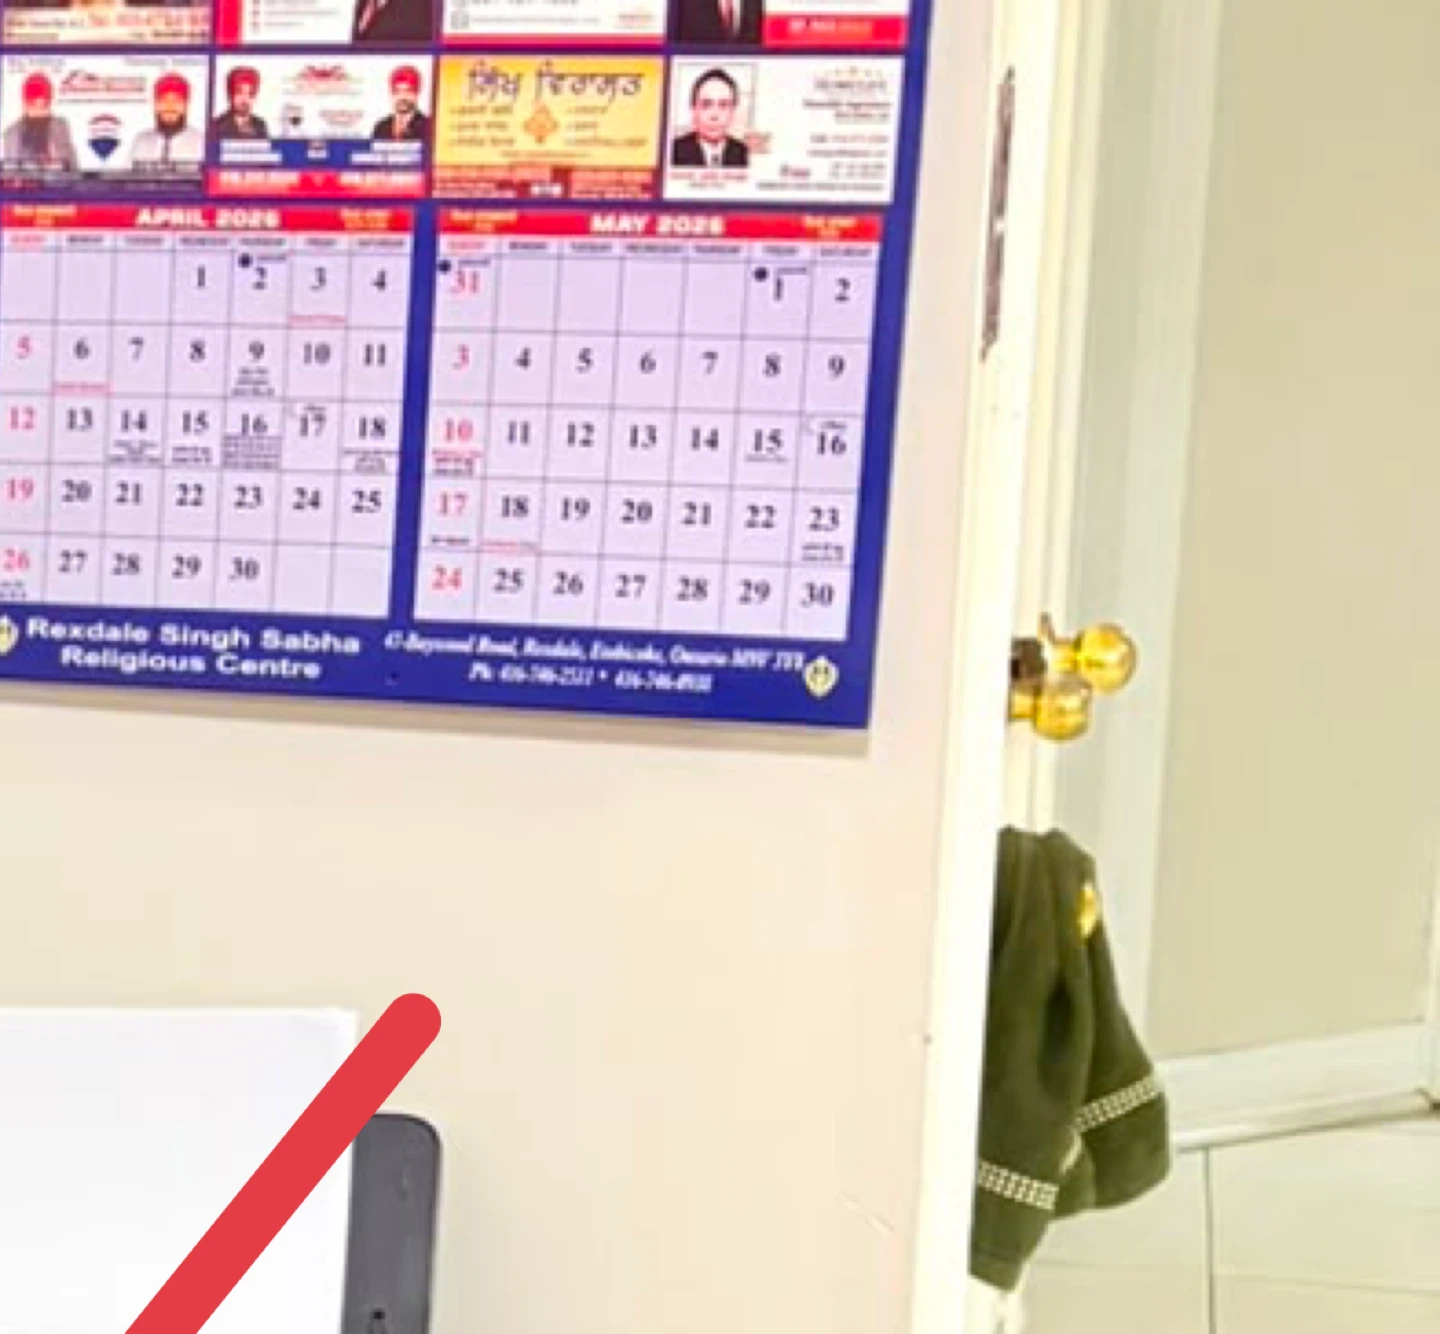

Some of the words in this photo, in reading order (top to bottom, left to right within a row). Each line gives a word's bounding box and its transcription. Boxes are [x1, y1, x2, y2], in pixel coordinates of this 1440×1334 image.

[136, 208, 207, 227] APRIL
[590, 215, 649, 232] MAY
[196, 265, 206, 289] 1
[252, 267, 268, 291] 2
[311, 267, 326, 291] 3
[371, 269, 387, 291] 4
[450, 271, 480, 293] 31
[774, 276, 782, 300] 1
[834, 278, 850, 302] 2
[17, 336, 30, 359] 5
[74, 339, 89, 360] 6
[129, 337, 144, 359] 7
[190, 341, 206, 361] 8
[249, 341, 265, 362] 9
[304, 343, 330, 365] 10
[364, 344, 386, 366] 11
[454, 345, 469, 368] 3
[516, 347, 531, 368] 4
[577, 348, 592, 373] 5
[640, 350, 656, 373] 6
[703, 351, 718, 374] 7
[764, 353, 780, 376] 8
[828, 354, 844, 377] 9
[9, 407, 35, 430] 12
[66, 408, 92, 430] 13
[120, 410, 147, 432] 14
[182, 411, 208, 434] 15
[241, 413, 268, 435] 16
[299, 414, 326, 436] 17
[358, 417, 386, 439] 18
[444, 419, 473, 441] 10
[507, 421, 530, 444] 11
[567, 424, 594, 447] 12
[629, 425, 657, 448] 13
[691, 426, 719, 450] 14
[754, 429, 782, 453] 15
[818, 431, 847, 454] 16
[8, 478, 34, 499] 19
[62, 480, 90, 501] 20
[115, 482, 142, 504] 21
[177, 484, 203, 506] 22
[235, 487, 262, 508] 23
[293, 488, 322, 510] 24
[352, 490, 380, 513] 25
[439, 493, 466, 515] 17
[501, 496, 529, 517] 18
[560, 498, 589, 520] 19
[622, 500, 651, 523] 20
[682, 503, 711, 525] 21
[745, 505, 775, 528] 22
[809, 508, 839, 531] 23
[3, 549, 30, 571] 26
[59, 551, 87, 573] 27
[113, 554, 140, 575] 28
[173, 556, 200, 578] 29
[230, 558, 259, 579] 30
[432, 567, 461, 589] 24
[493, 569, 523, 591] 25
[553, 572, 583, 595] 26
[616, 574, 646, 597] 27
[678, 577, 708, 600] 28
[739, 580, 770, 602] 29
[802, 583, 834, 606] 30
[26, 616, 150, 644] Rexdale
[158, 623, 250, 653] Singh
[259, 627, 361, 655] Sabha
[60, 644, 206, 674] Religious
[217, 651, 322, 680] Centre
